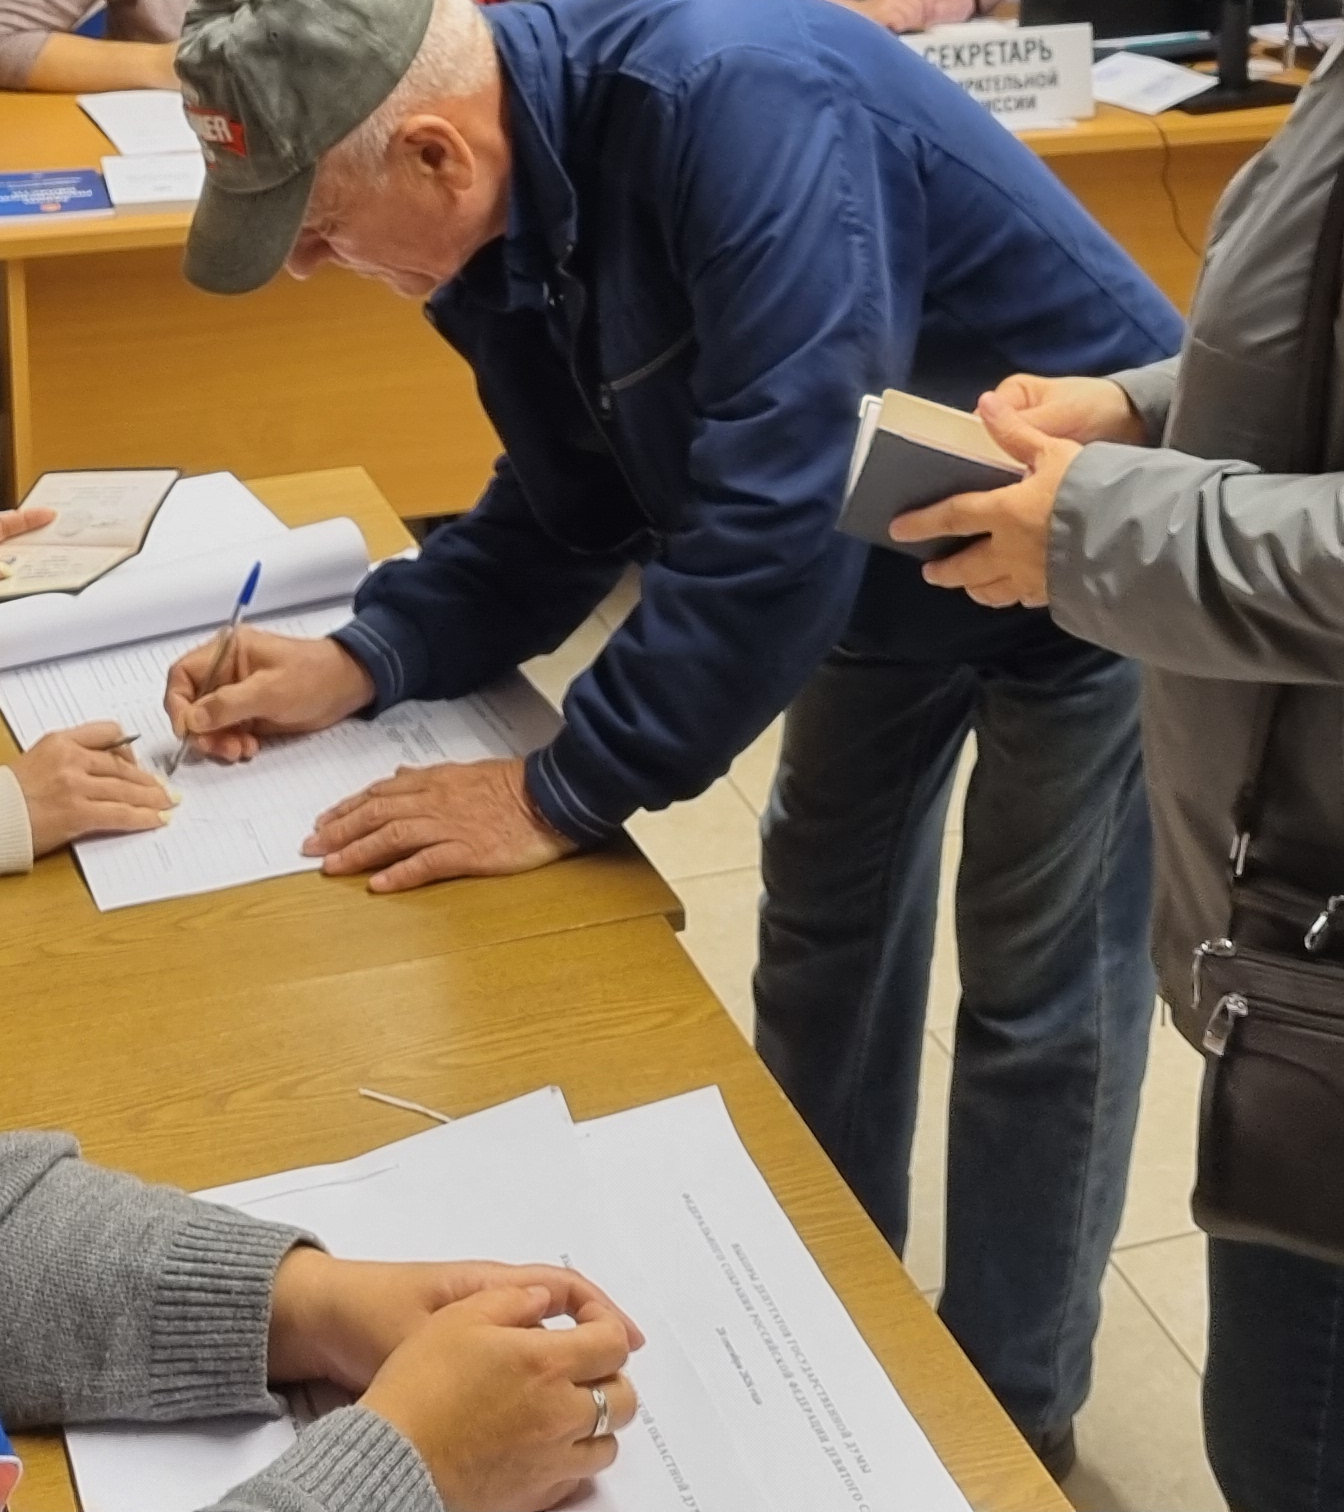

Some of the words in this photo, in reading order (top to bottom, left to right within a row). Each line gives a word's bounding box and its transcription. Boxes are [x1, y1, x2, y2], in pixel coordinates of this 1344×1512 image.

[925, 38, 1052, 68] СЕКРЕТАРЬ
[961, 69, 1058, 91] РАТЕЛЬНОЙ
[682, 1192, 726, 1263] ФЕДЕРАЛЬНОГО
[721, 1261, 754, 1314] СОБРАНИЯ
[749, 1310, 795, 1380] РОССИЙСКОЙ
[789, 1379, 830, 1447] ФЕДЕРАЦИИ
[822, 1442, 863, 1502] ДЕВЯТОГО
[731, 1242, 760, 1285] ВЫБОРЫ
[756, 1282, 793, 1340] ДЕПУТАТОВ
[787, 1335, 854, 1440] ГОСУДАРСТВЕННОЙ
[844, 1437, 872, 1474] ДУМЫ
[647, 1423, 690, 1495] ОБЛАСТНОЙ
